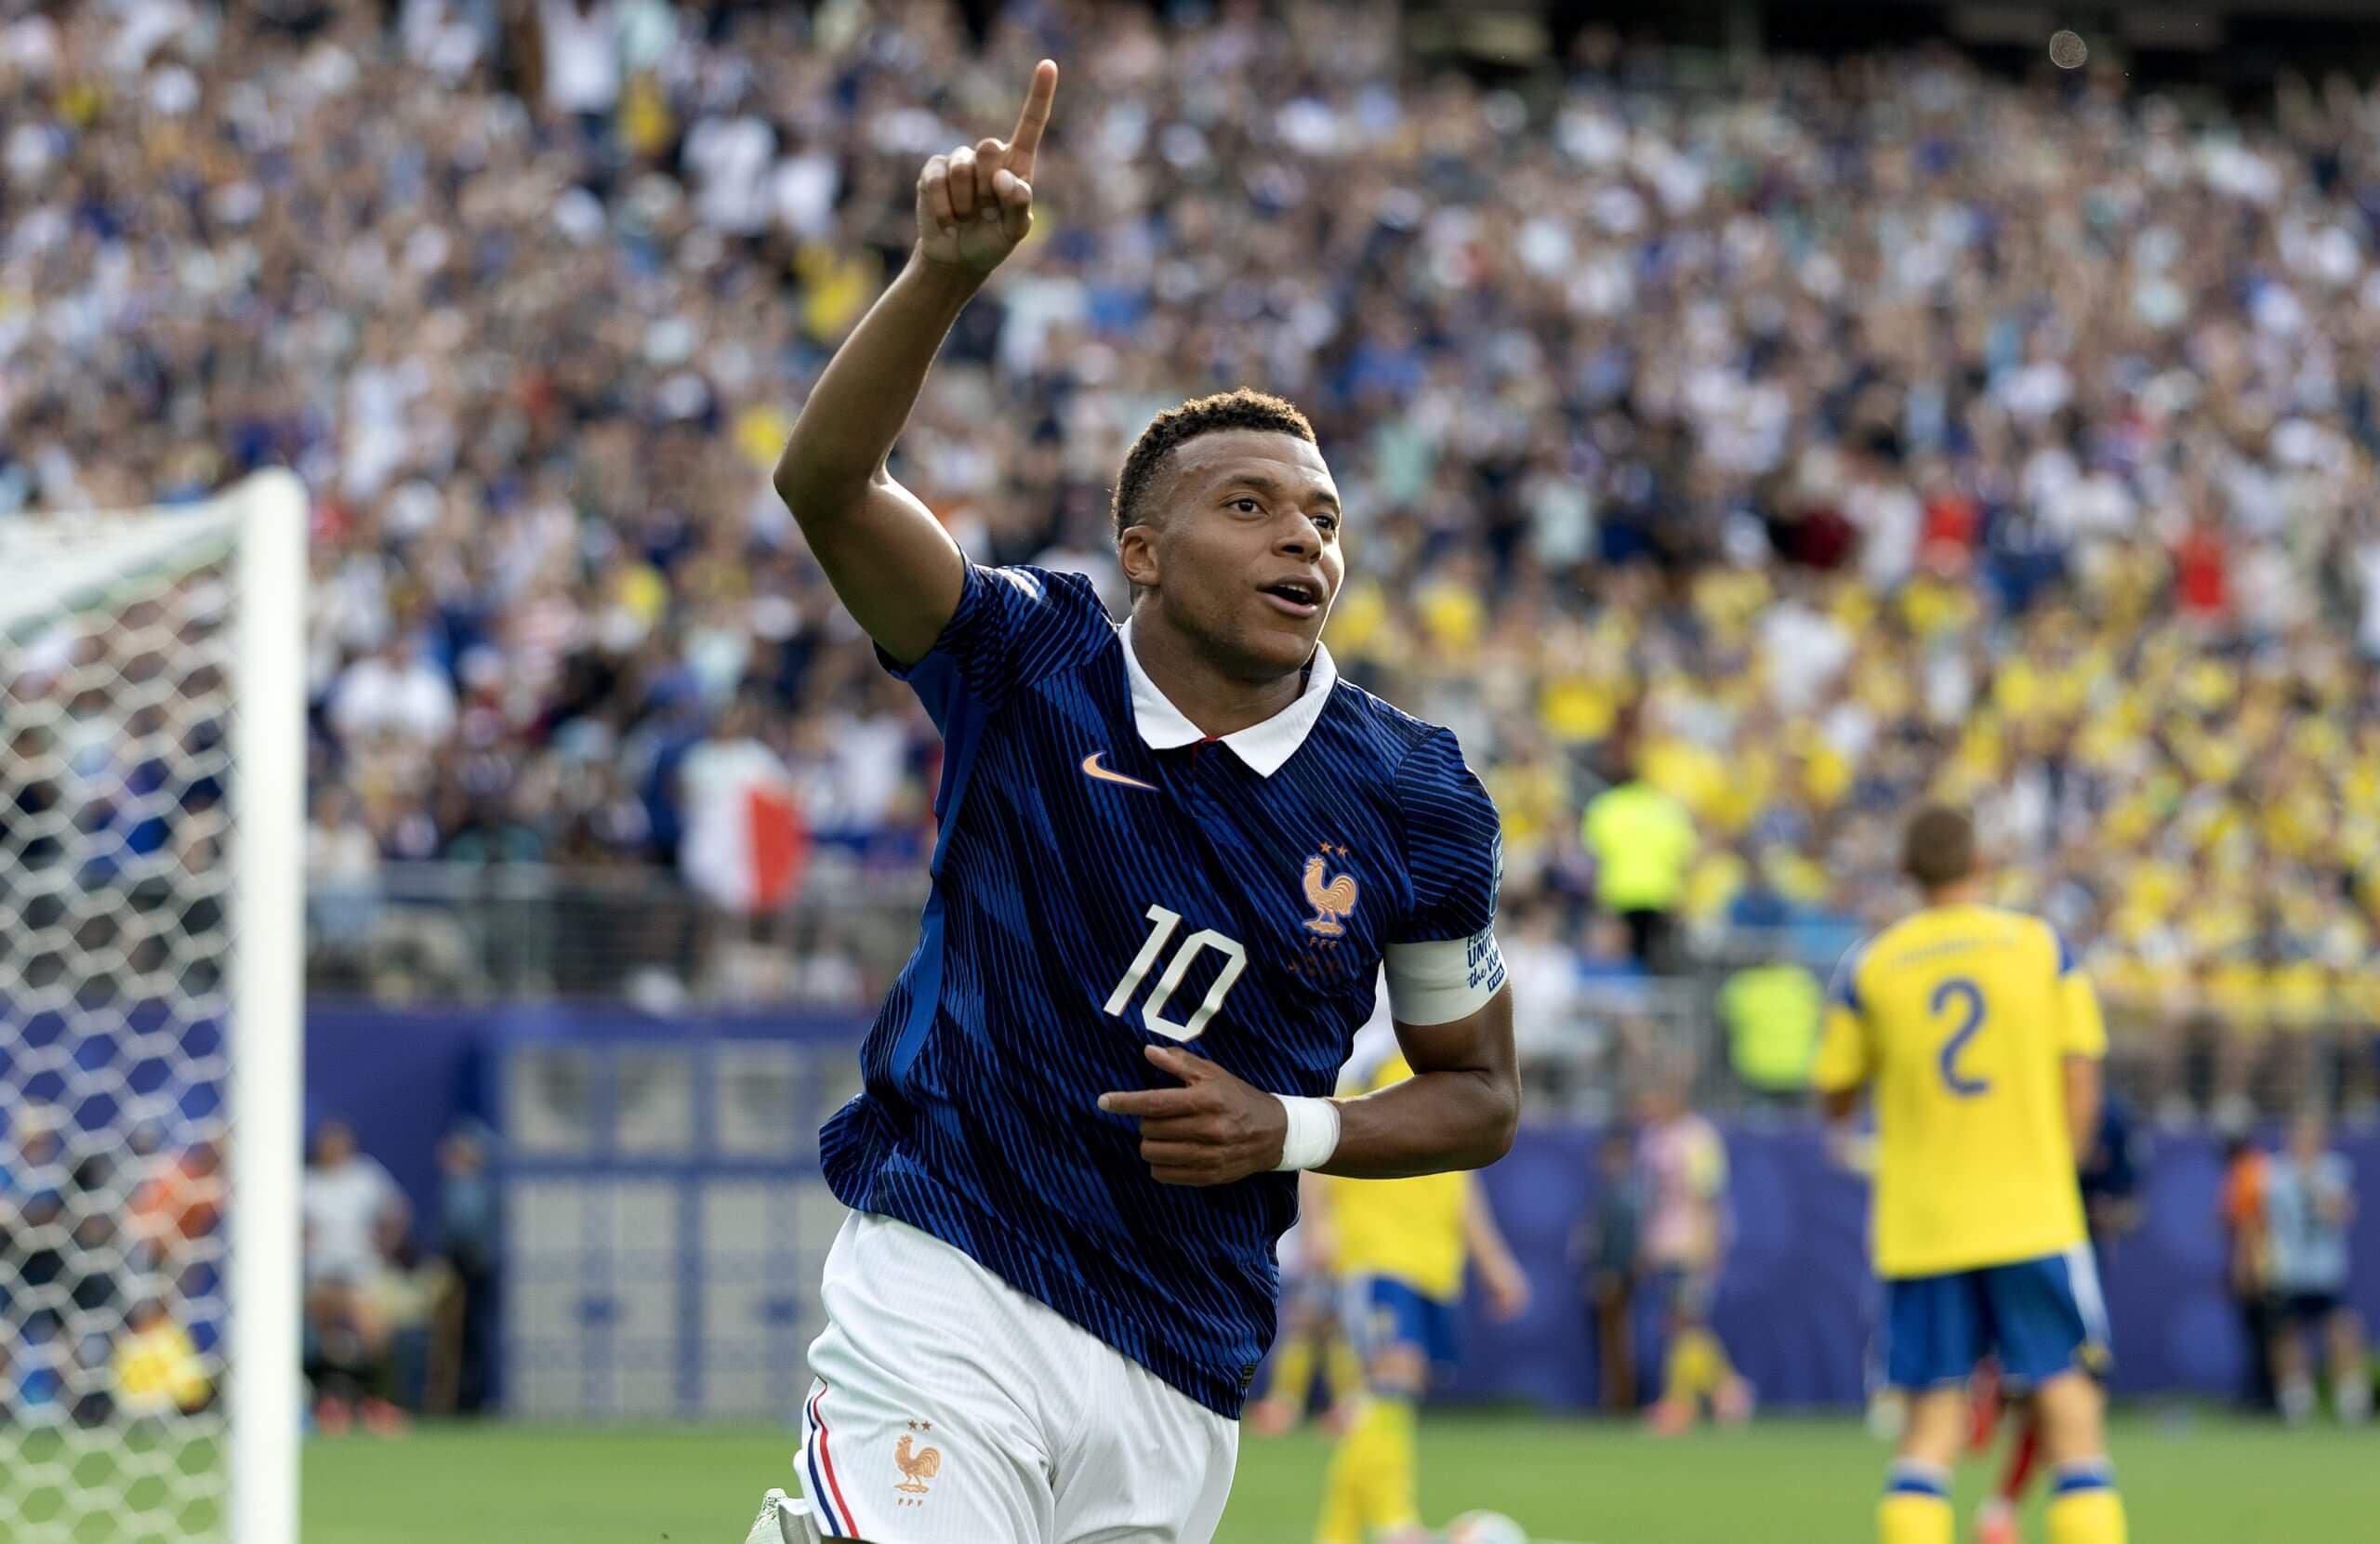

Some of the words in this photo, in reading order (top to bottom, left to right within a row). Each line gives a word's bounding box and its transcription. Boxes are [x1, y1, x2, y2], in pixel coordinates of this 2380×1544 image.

[1104, 904, 1248, 1042] 10
[1466, 968, 1487, 988] the
[1931, 976, 1989, 1097] 2
